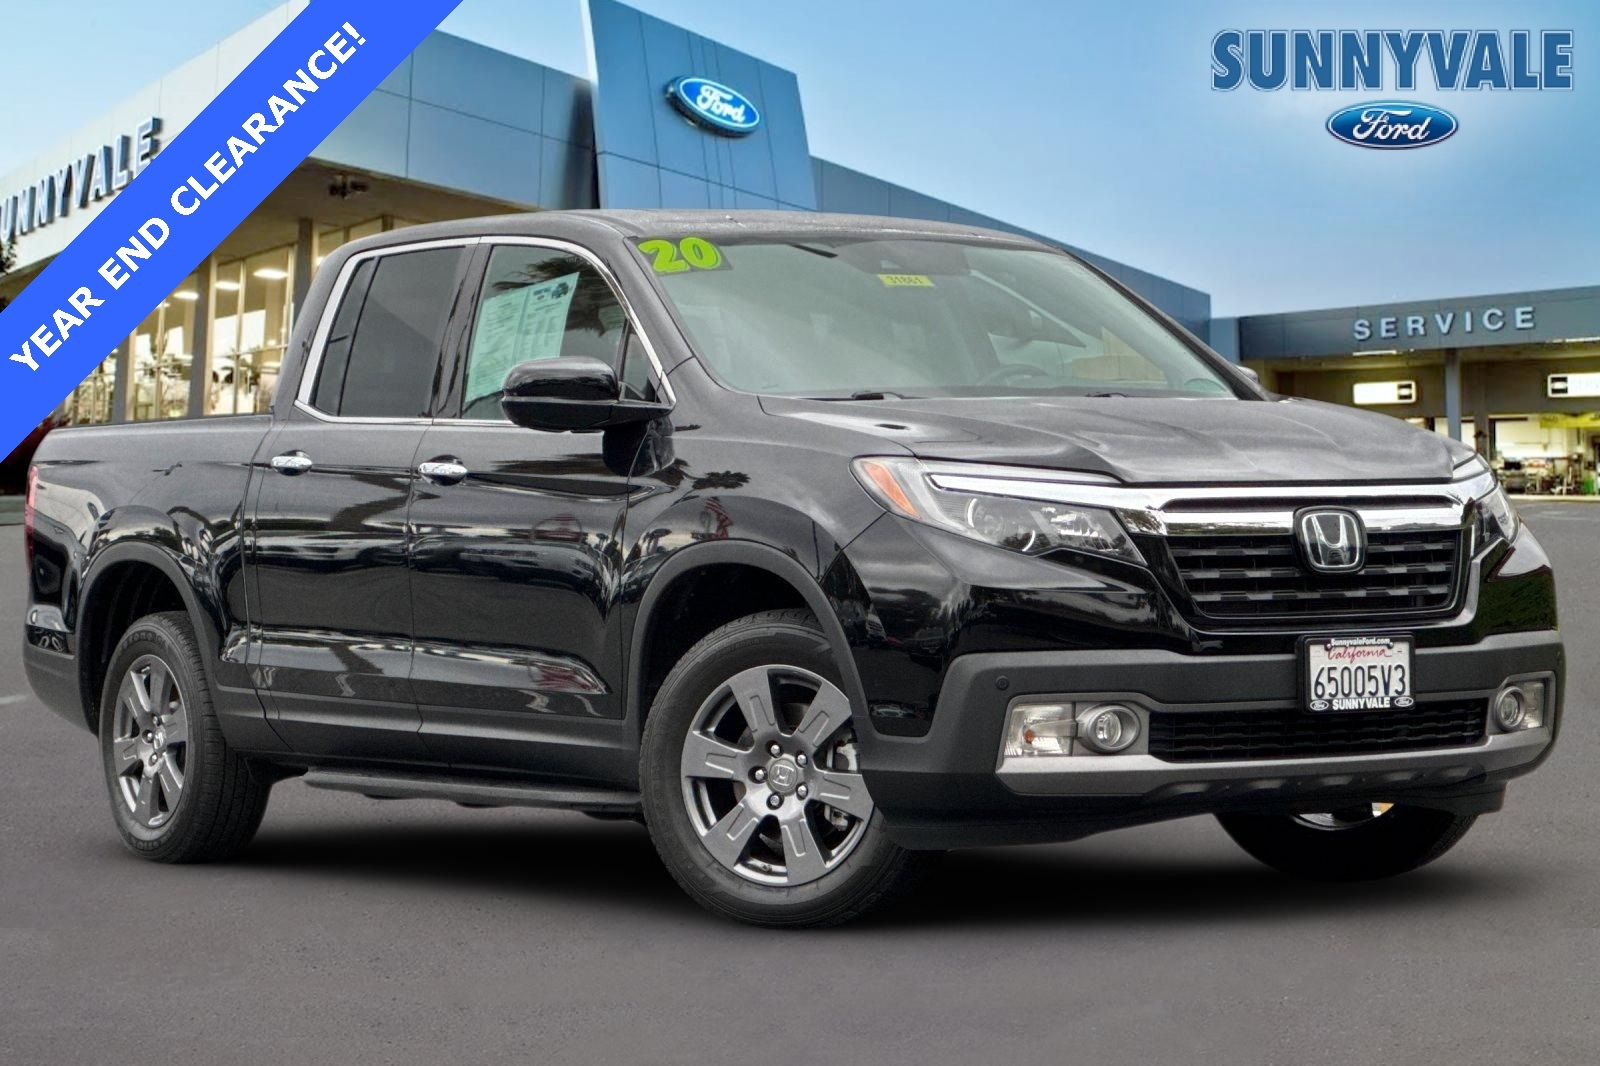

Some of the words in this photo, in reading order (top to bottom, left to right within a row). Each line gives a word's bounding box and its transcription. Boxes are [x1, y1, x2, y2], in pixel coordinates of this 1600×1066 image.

[697, 85, 746, 122] Ford
[0, 117, 162, 244] UNNYVALE
[638, 236, 722, 273] 20
[1353, 306, 1535, 341] SERVICE
[1327, 646, 1392, 663] California
[1314, 664, 1406, 699] 65005V3
[1332, 697, 1391, 711] SUNNYVALE
